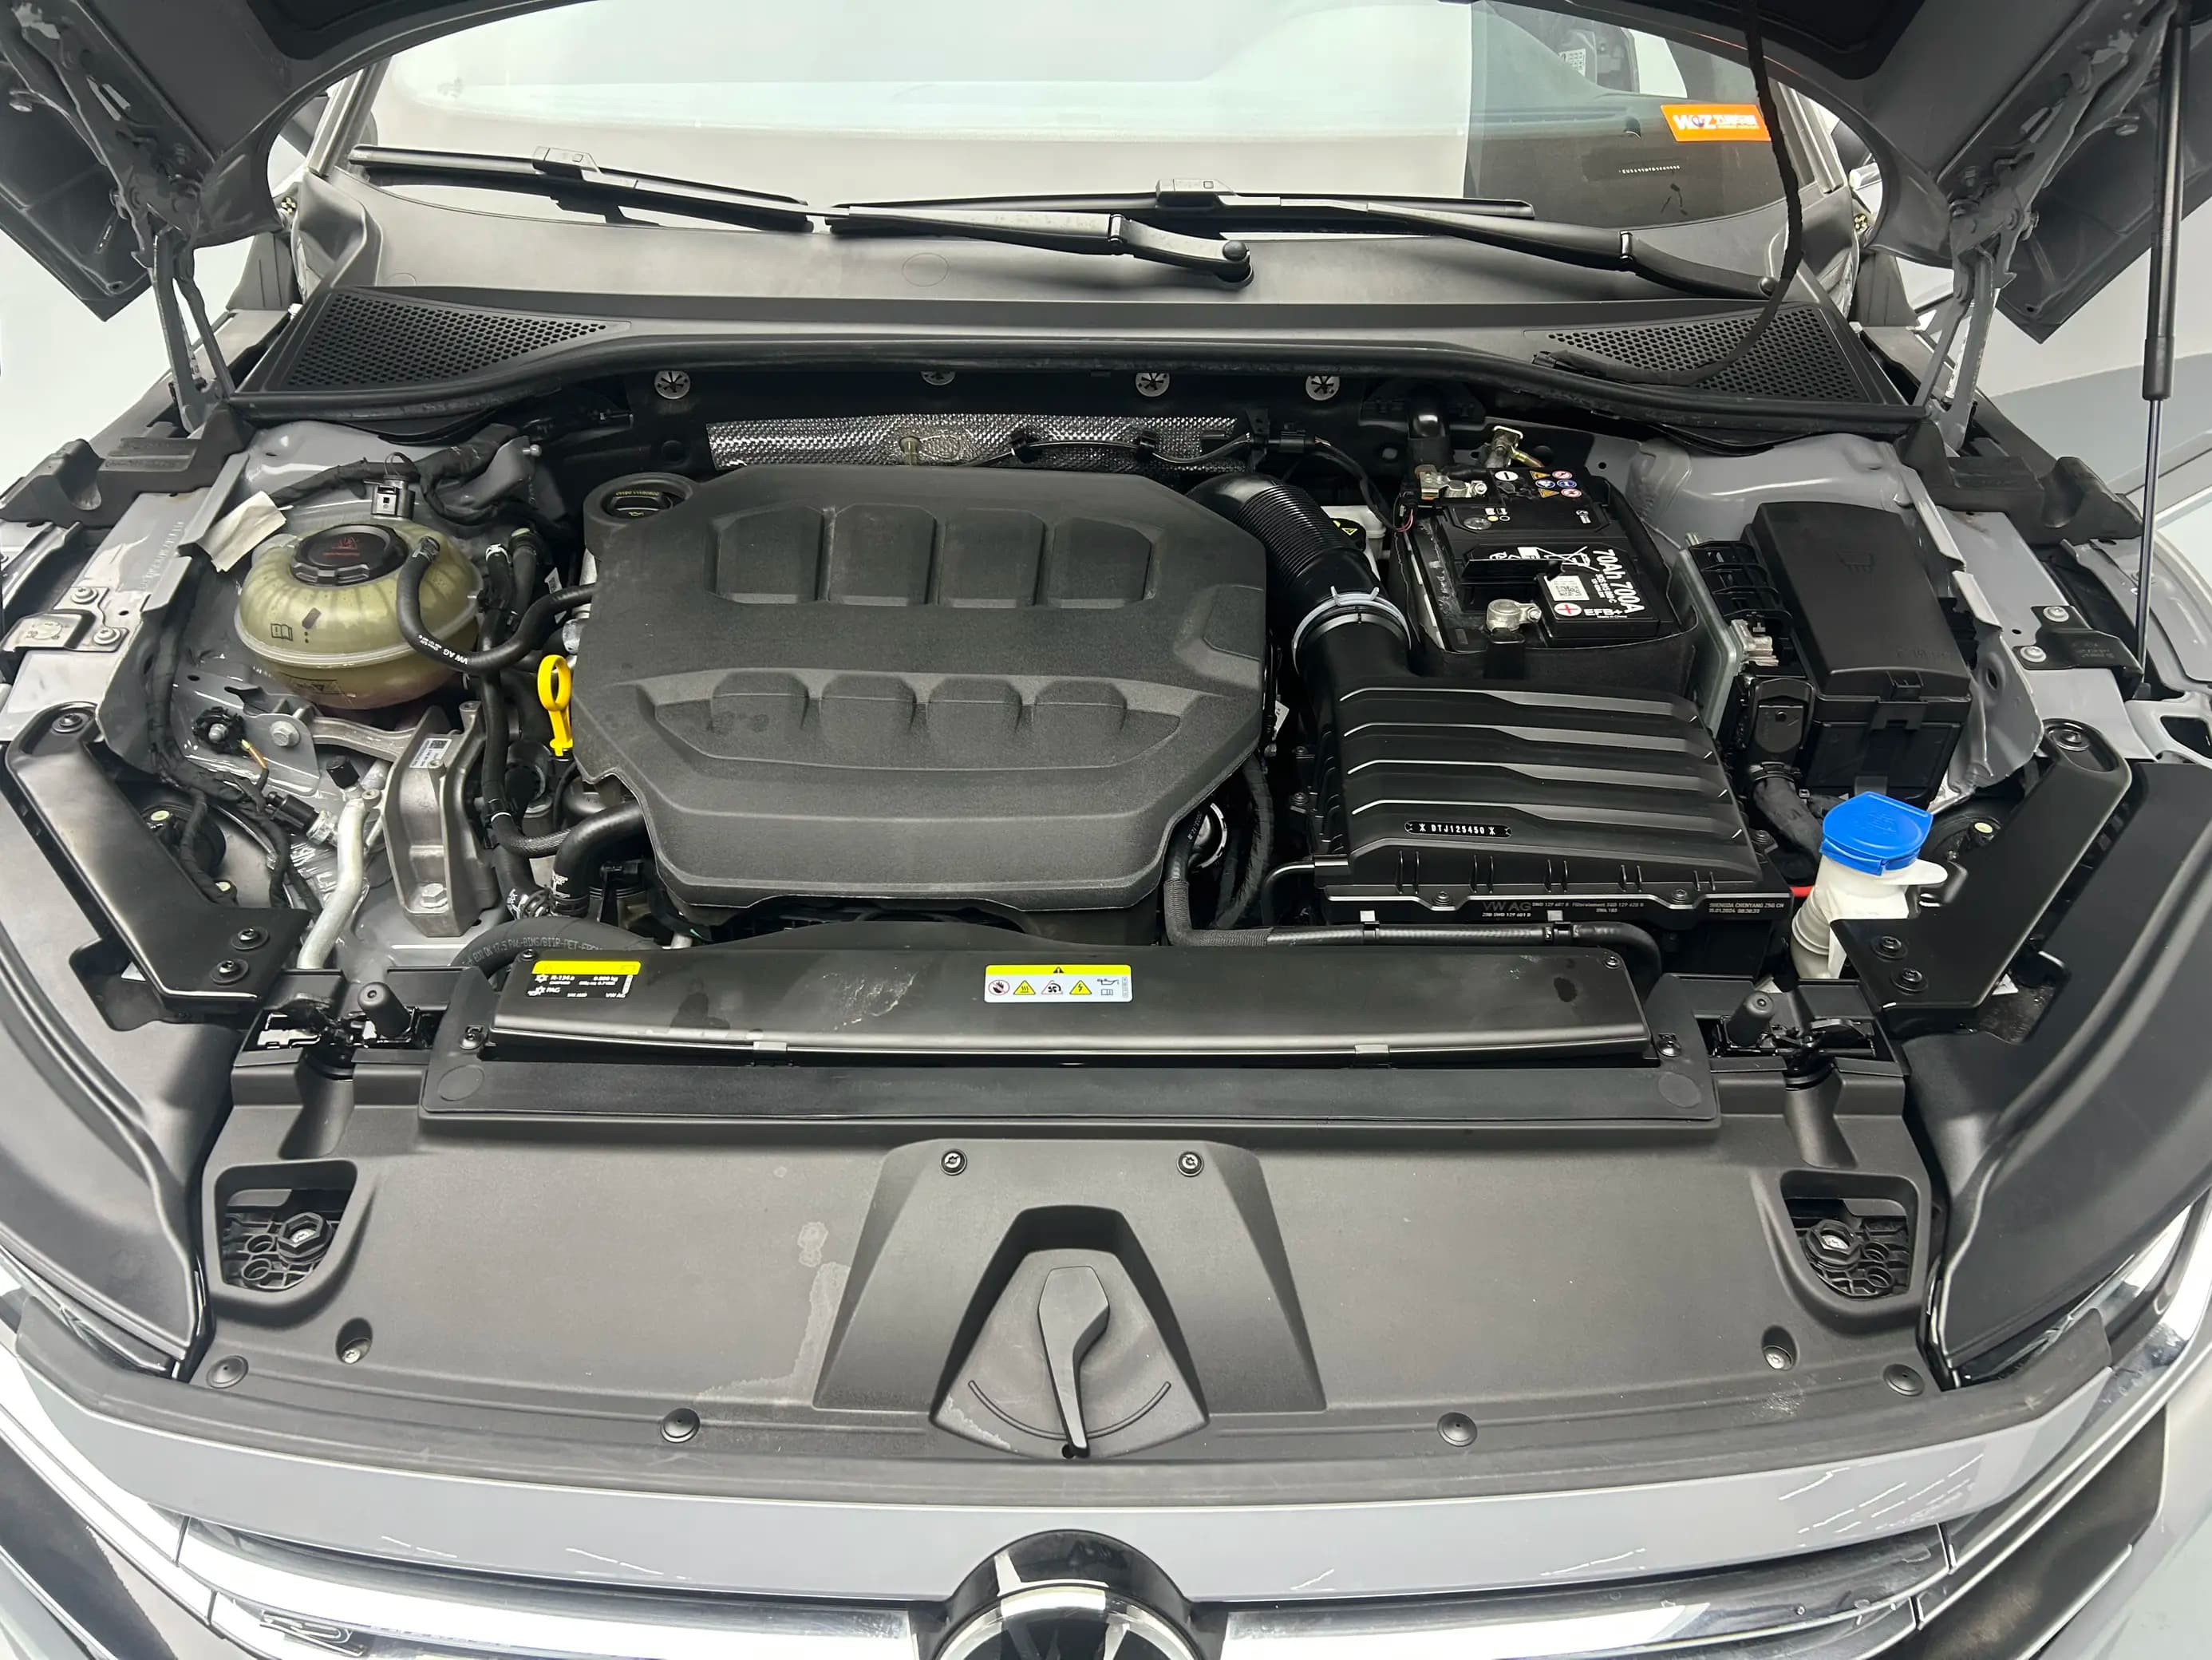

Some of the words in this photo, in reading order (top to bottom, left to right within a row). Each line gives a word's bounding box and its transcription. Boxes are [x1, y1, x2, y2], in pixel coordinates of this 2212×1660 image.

[1593, 549, 1625, 579] 70Ah
[1610, 582, 1645, 614] 700A
[443, 648, 456, 658] AG
[454, 654, 468, 665] VW
[1482, 901, 1508, 911] VW
[1509, 901, 1531, 911] AG
